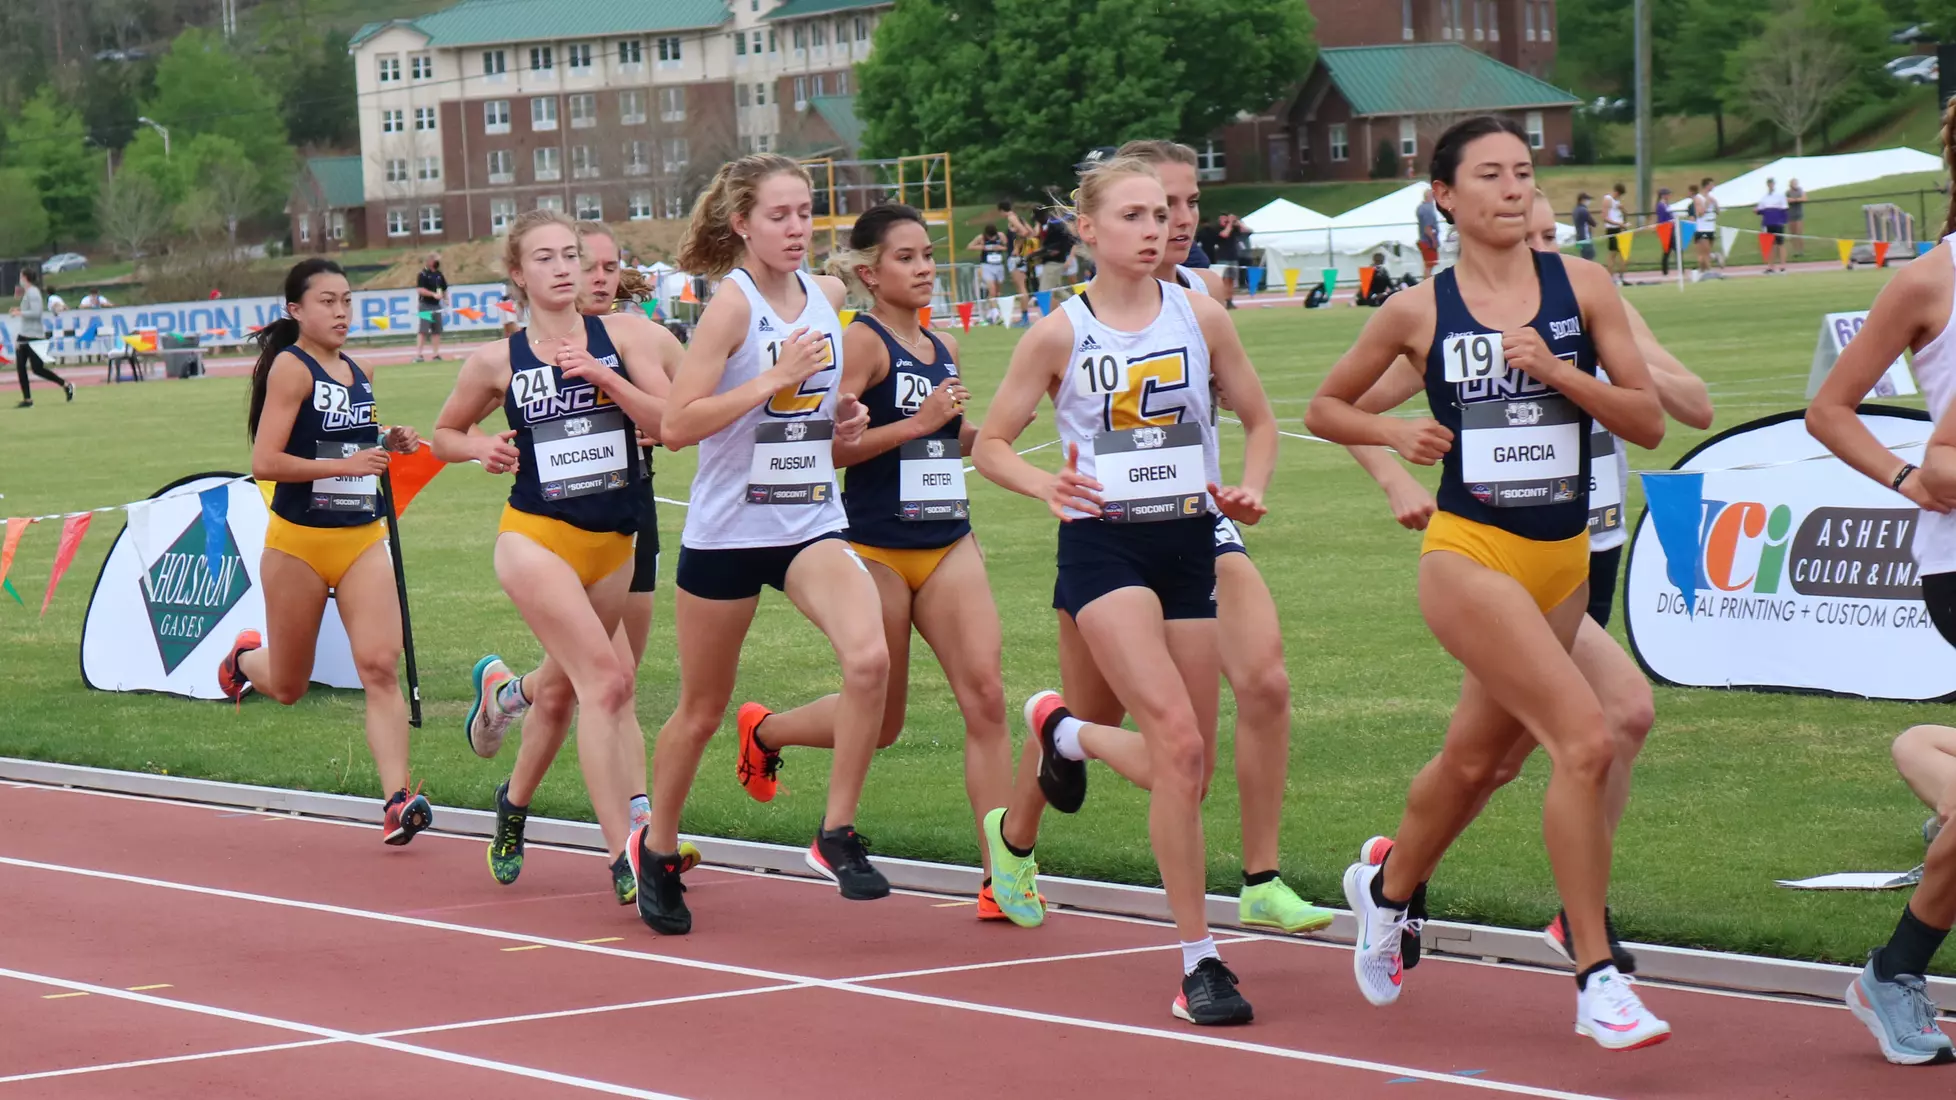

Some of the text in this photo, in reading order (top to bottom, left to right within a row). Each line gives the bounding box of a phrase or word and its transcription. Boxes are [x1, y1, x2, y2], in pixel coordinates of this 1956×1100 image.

[361, 297, 410, 330] BE
[1549, 316, 1581, 340] SOCON
[595, 353, 620, 368] OCON
[766, 341, 784, 367] 1
[1453, 336, 1493, 378] 19
[516, 370, 549, 403] 24
[1081, 355, 1119, 393] 10
[319, 384, 348, 413] 32
[550, 445, 615, 467] MCCASLIN
[770, 455, 816, 470] RUSSUM
[1494, 444, 1556, 463] GARCIA
[922, 473, 952, 486] REITER
[1129, 464, 1177, 483] GREEN
[1182, 496, 1199, 515] C
[1816, 518, 1910, 549] ASHEV
[1795, 558, 1923, 587] COLOR & IMA
[1657, 592, 1714, 617] DIGAL
[1720, 597, 1796, 622] PRINTING
[1816, 602, 1887, 628] CUSTOM
[1893, 605, 1934, 629] GRA
[160, 613, 205, 638] GASES
